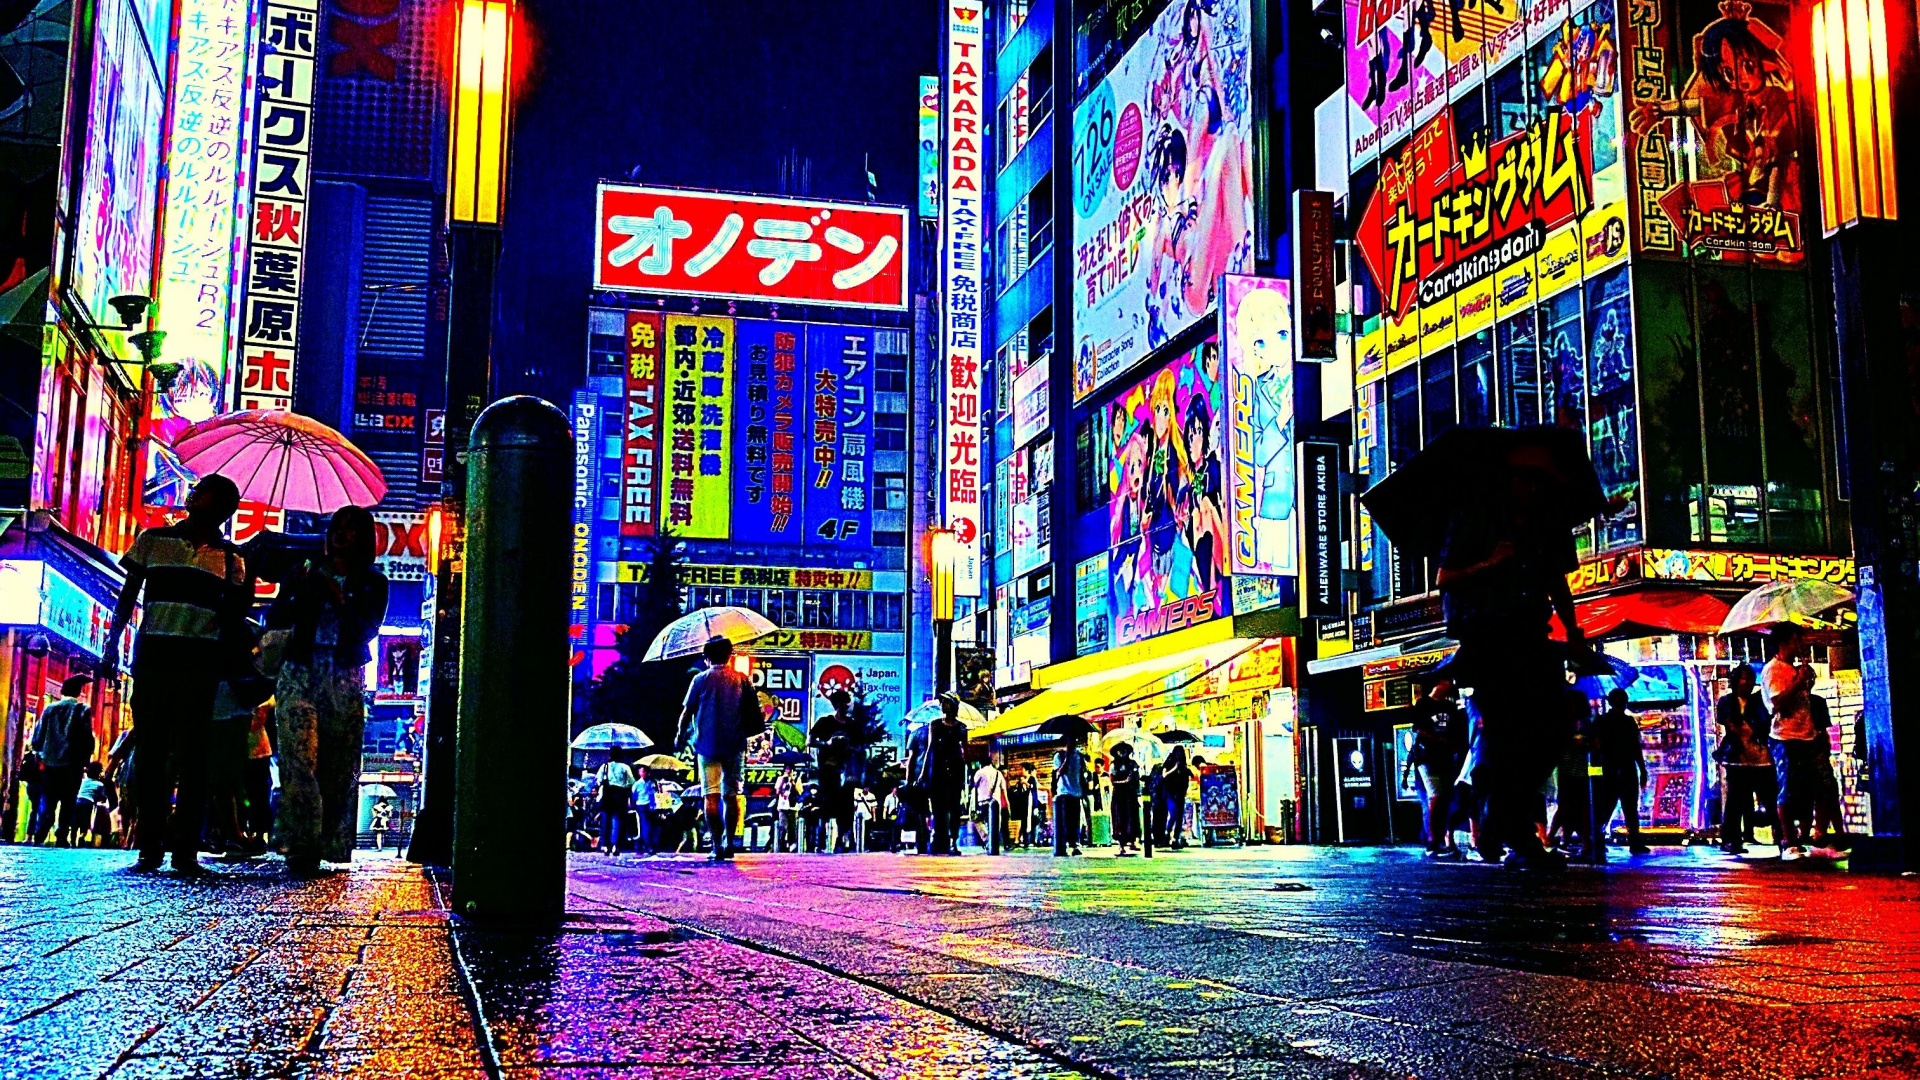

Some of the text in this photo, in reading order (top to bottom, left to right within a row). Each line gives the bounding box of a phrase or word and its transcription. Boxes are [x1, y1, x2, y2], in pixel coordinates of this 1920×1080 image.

[952, 41, 977, 192] TAKARADA
[1095, 148, 1113, 190] SALE
[607, 205, 899, 290] オノデン
[1388, 112, 1588, 312] カードキングダム
[1705, 236, 1772, 250] Cardkindom
[951, 274, 978, 350] 免税商店
[625, 321, 656, 524] 免税 TAX FREE
[745, 343, 769, 504] お見積り無料です
[840, 334, 867, 511] エアコン扇風機
[949, 353, 978, 505] 歓迎光臨
[1232, 366, 1257, 568] GAMERS
[571, 403, 595, 610] Panasonic ONODEN
[817, 518, 860, 541] 4F
[1317, 455, 1329, 605] ALIENWARE STORE AKIBA
[680, 567, 736, 585] FREE
[1118, 591, 1216, 641] GAMERS
[751, 668, 803, 690] DEN
[863, 682, 900, 692] Tax-free
[866, 668, 900, 679] Japan.
[876, 693, 900, 704] Shop
[747, 769, 783, 783] オノデ
